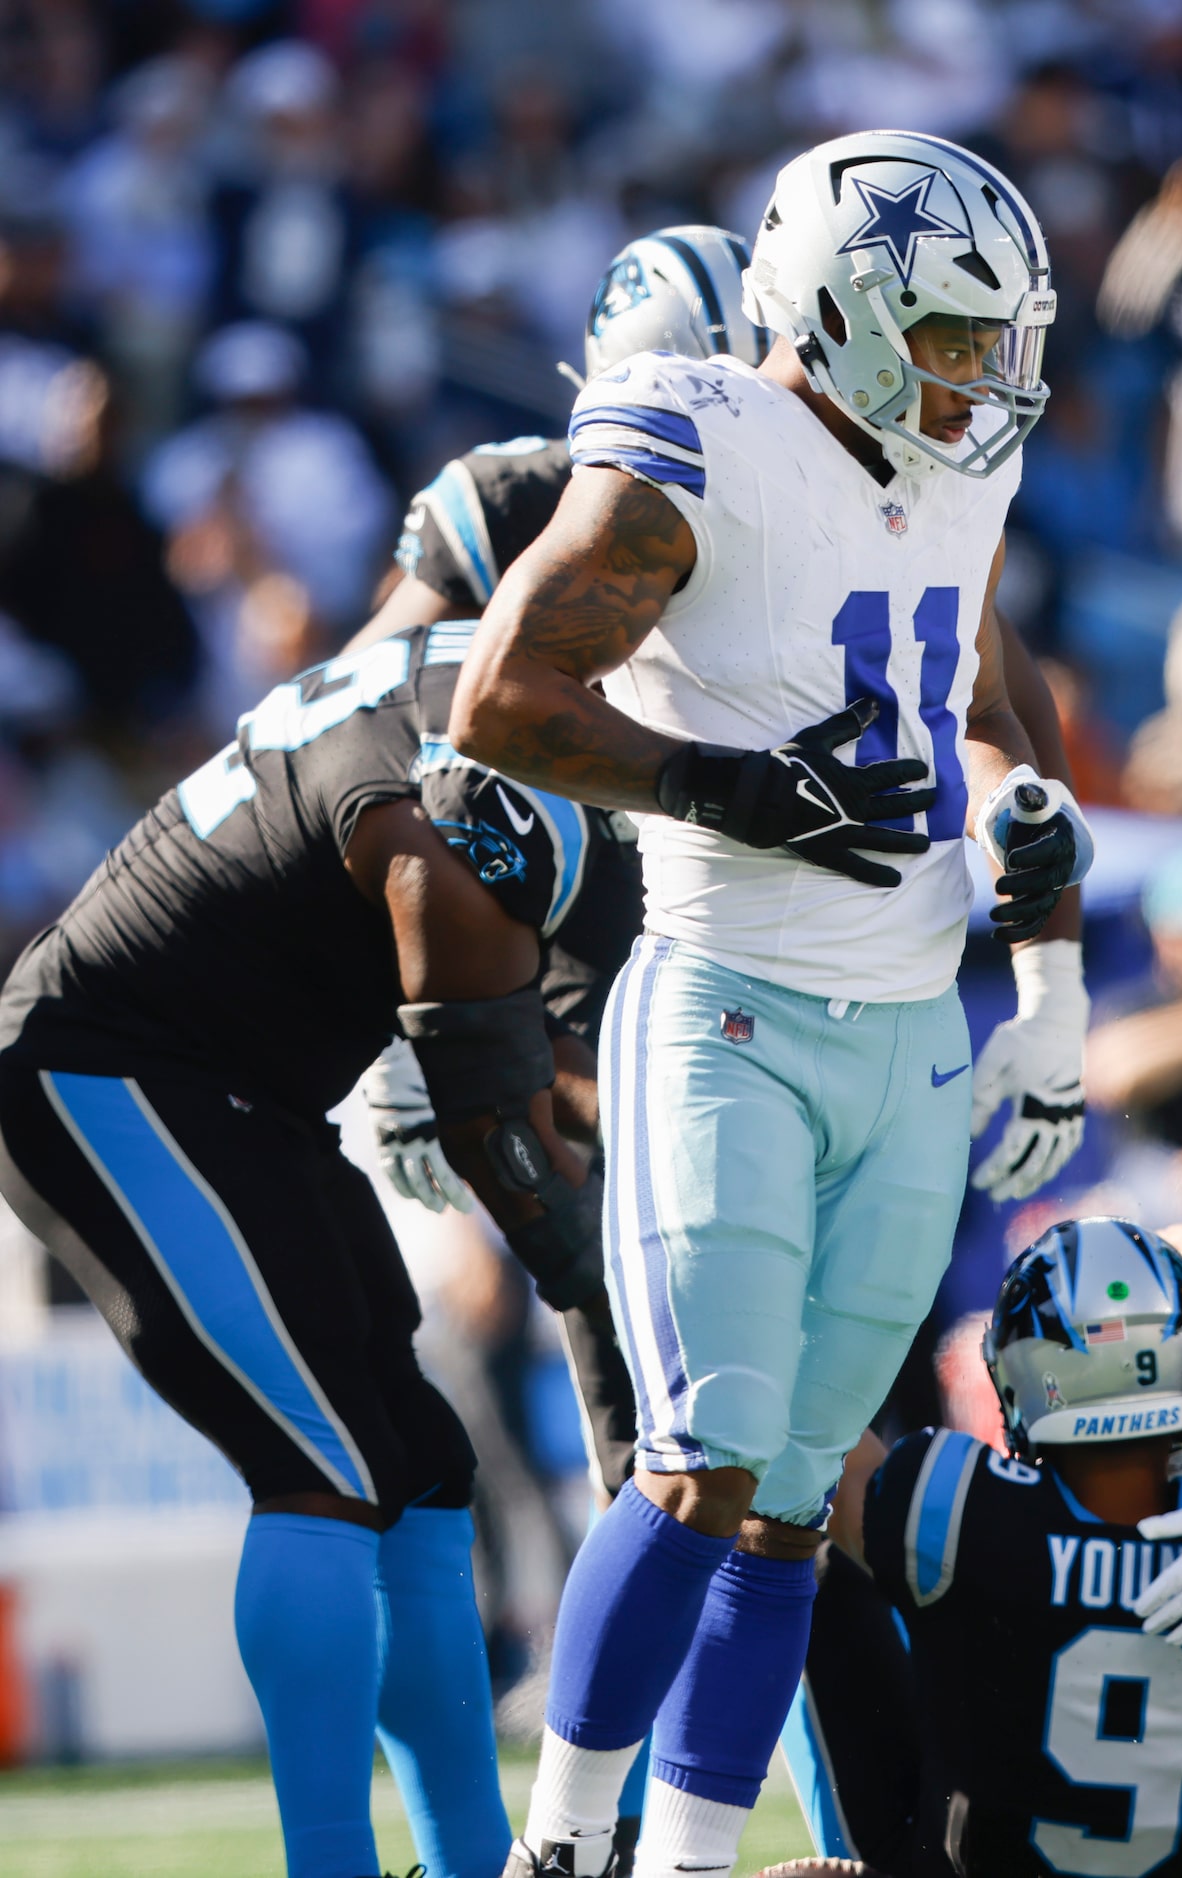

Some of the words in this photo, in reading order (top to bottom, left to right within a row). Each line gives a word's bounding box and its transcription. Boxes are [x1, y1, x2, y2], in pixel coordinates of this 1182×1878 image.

[831, 586, 968, 842] 11
[727, 1021, 749, 1038] NFL
[1134, 1347, 1158, 1387] 9
[1073, 1404, 1181, 1437] PANTHERS
